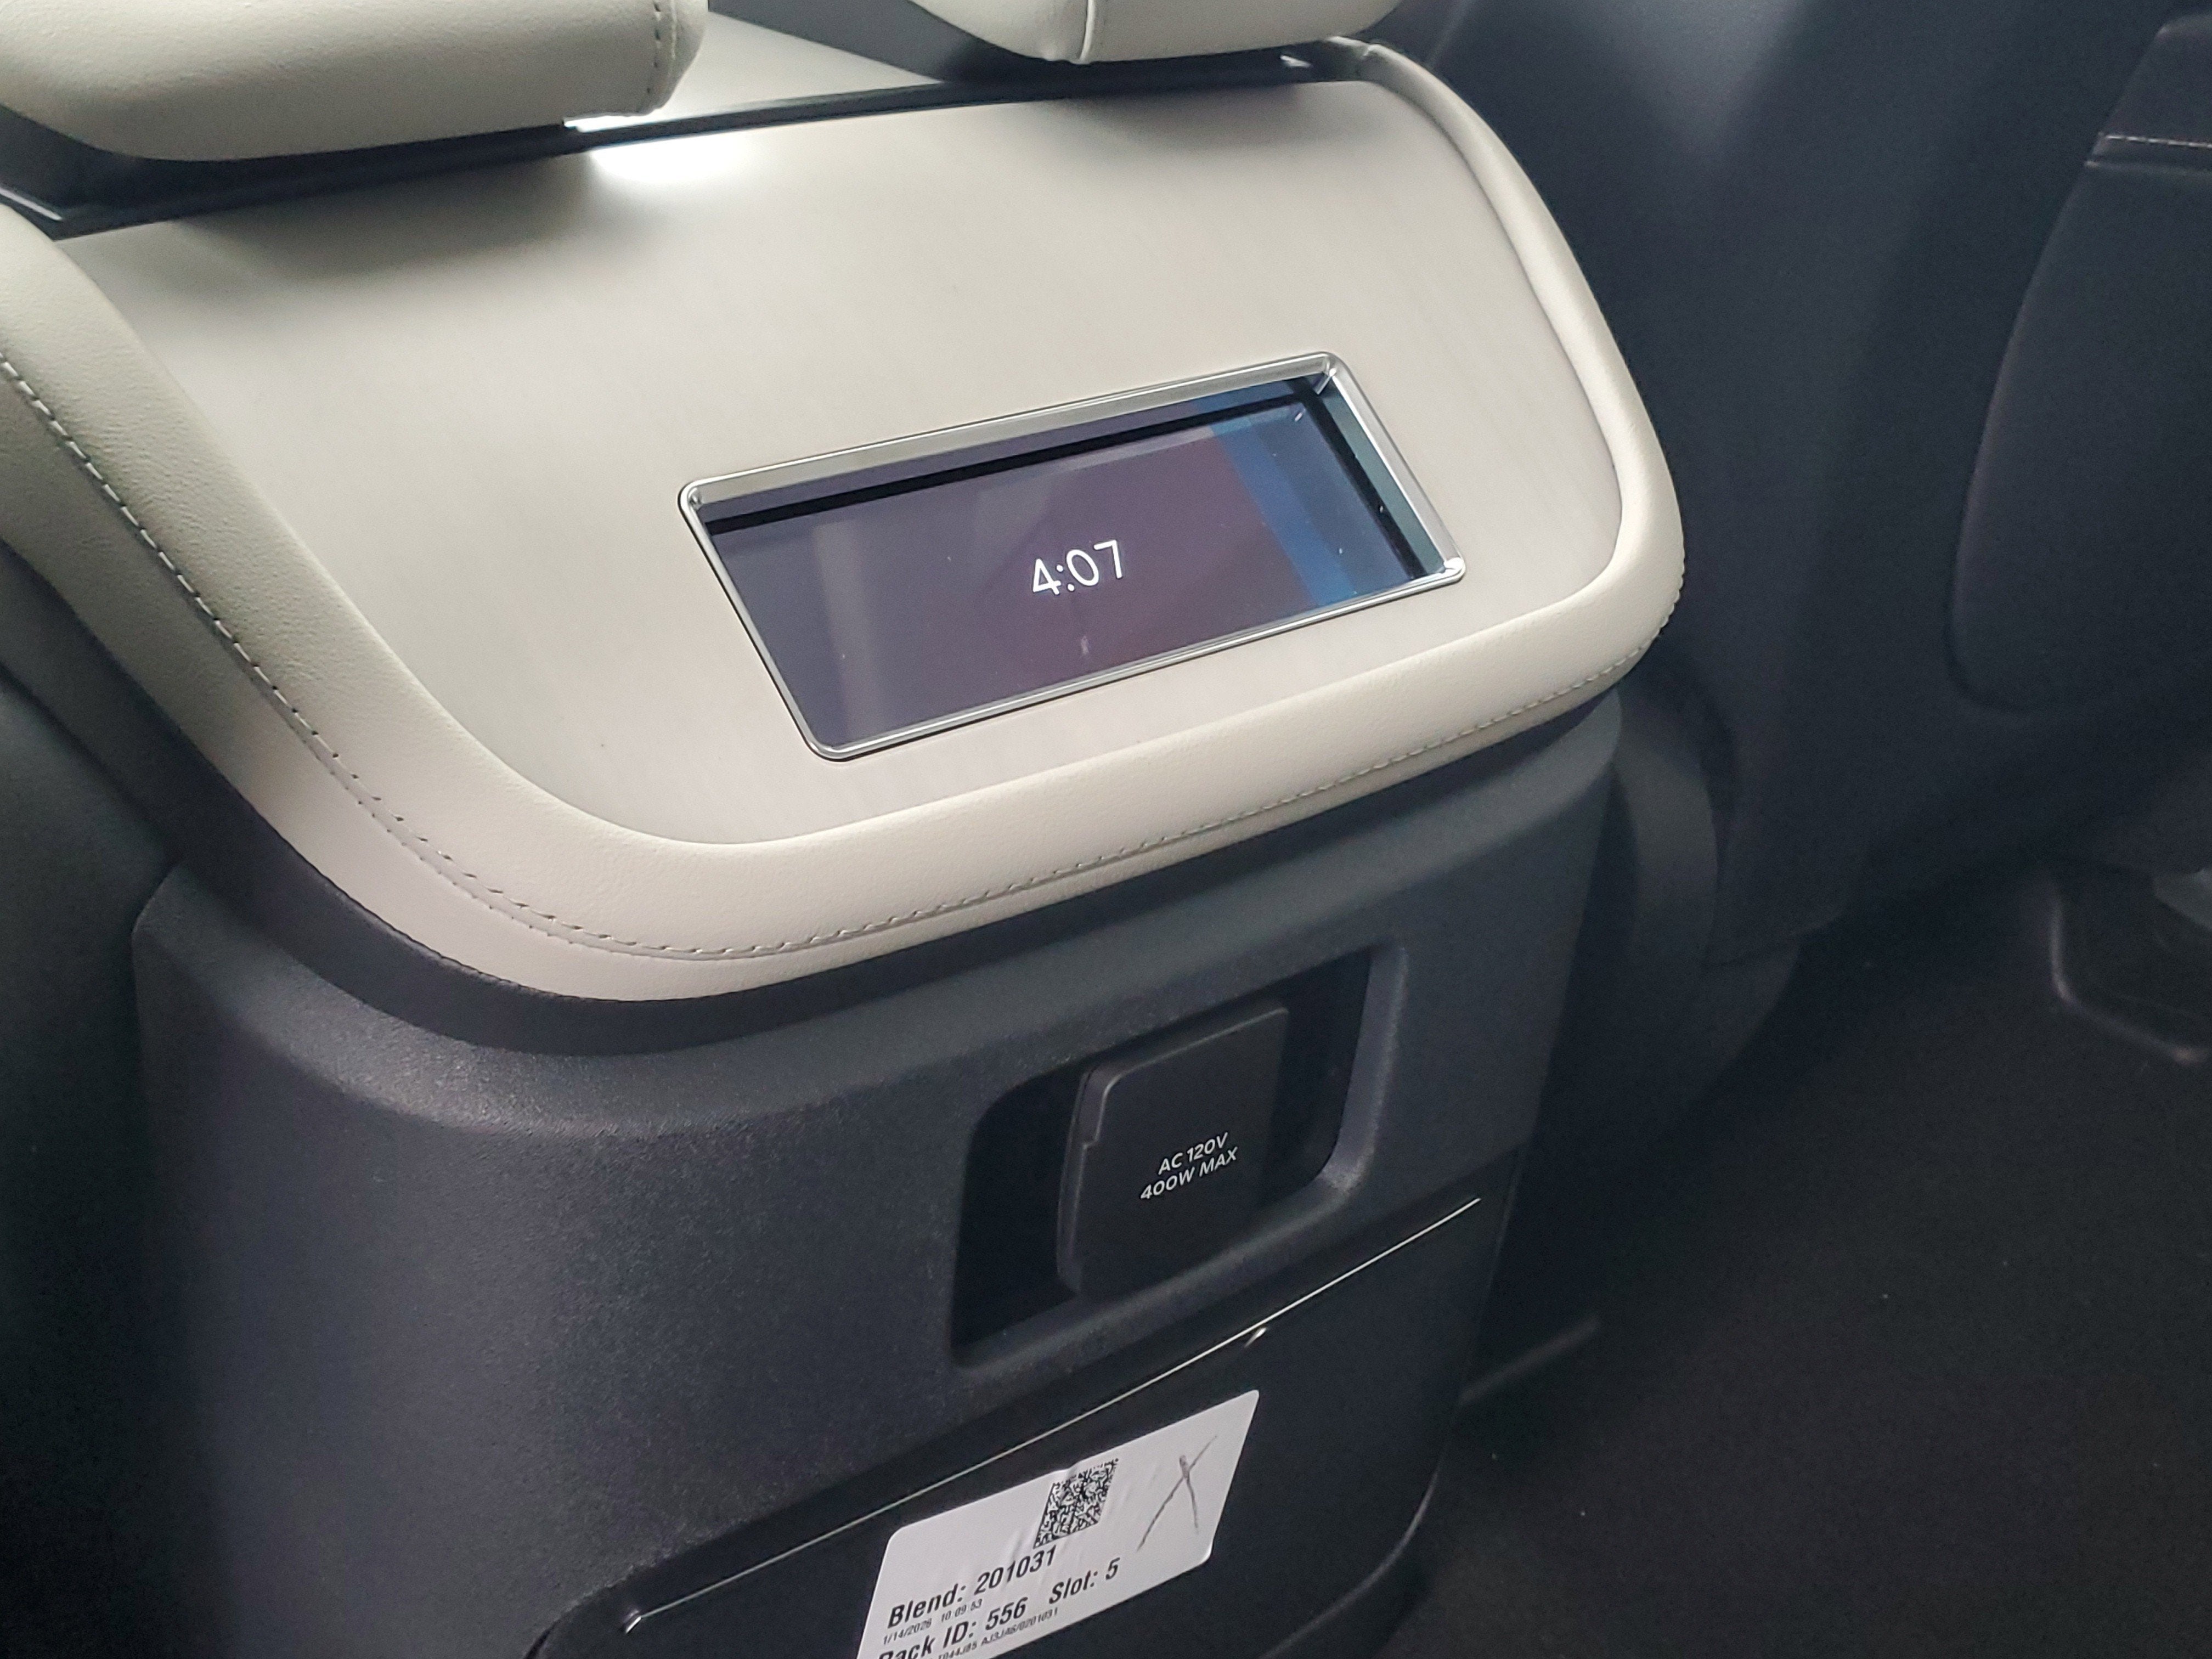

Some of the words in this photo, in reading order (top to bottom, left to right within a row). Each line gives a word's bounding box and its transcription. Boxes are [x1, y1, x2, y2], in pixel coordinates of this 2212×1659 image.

[1033, 540, 1122, 595] 4:07
[1140, 1167, 1195, 1199] 400W
[1199, 1147, 1238, 1177] MAX
[1158, 1153, 1183, 1175] AC
[1187, 1132, 1228, 1163] 120V
[887, 1583, 966, 1628] Blend:
[974, 1544, 1056, 1595] 201031
[943, 1621, 977, 1649] ID:
[985, 1597, 1028, 1630] 556
[1049, 1571, 1098, 1604] Slot:
[1105, 1558, 1120, 1580] 5
